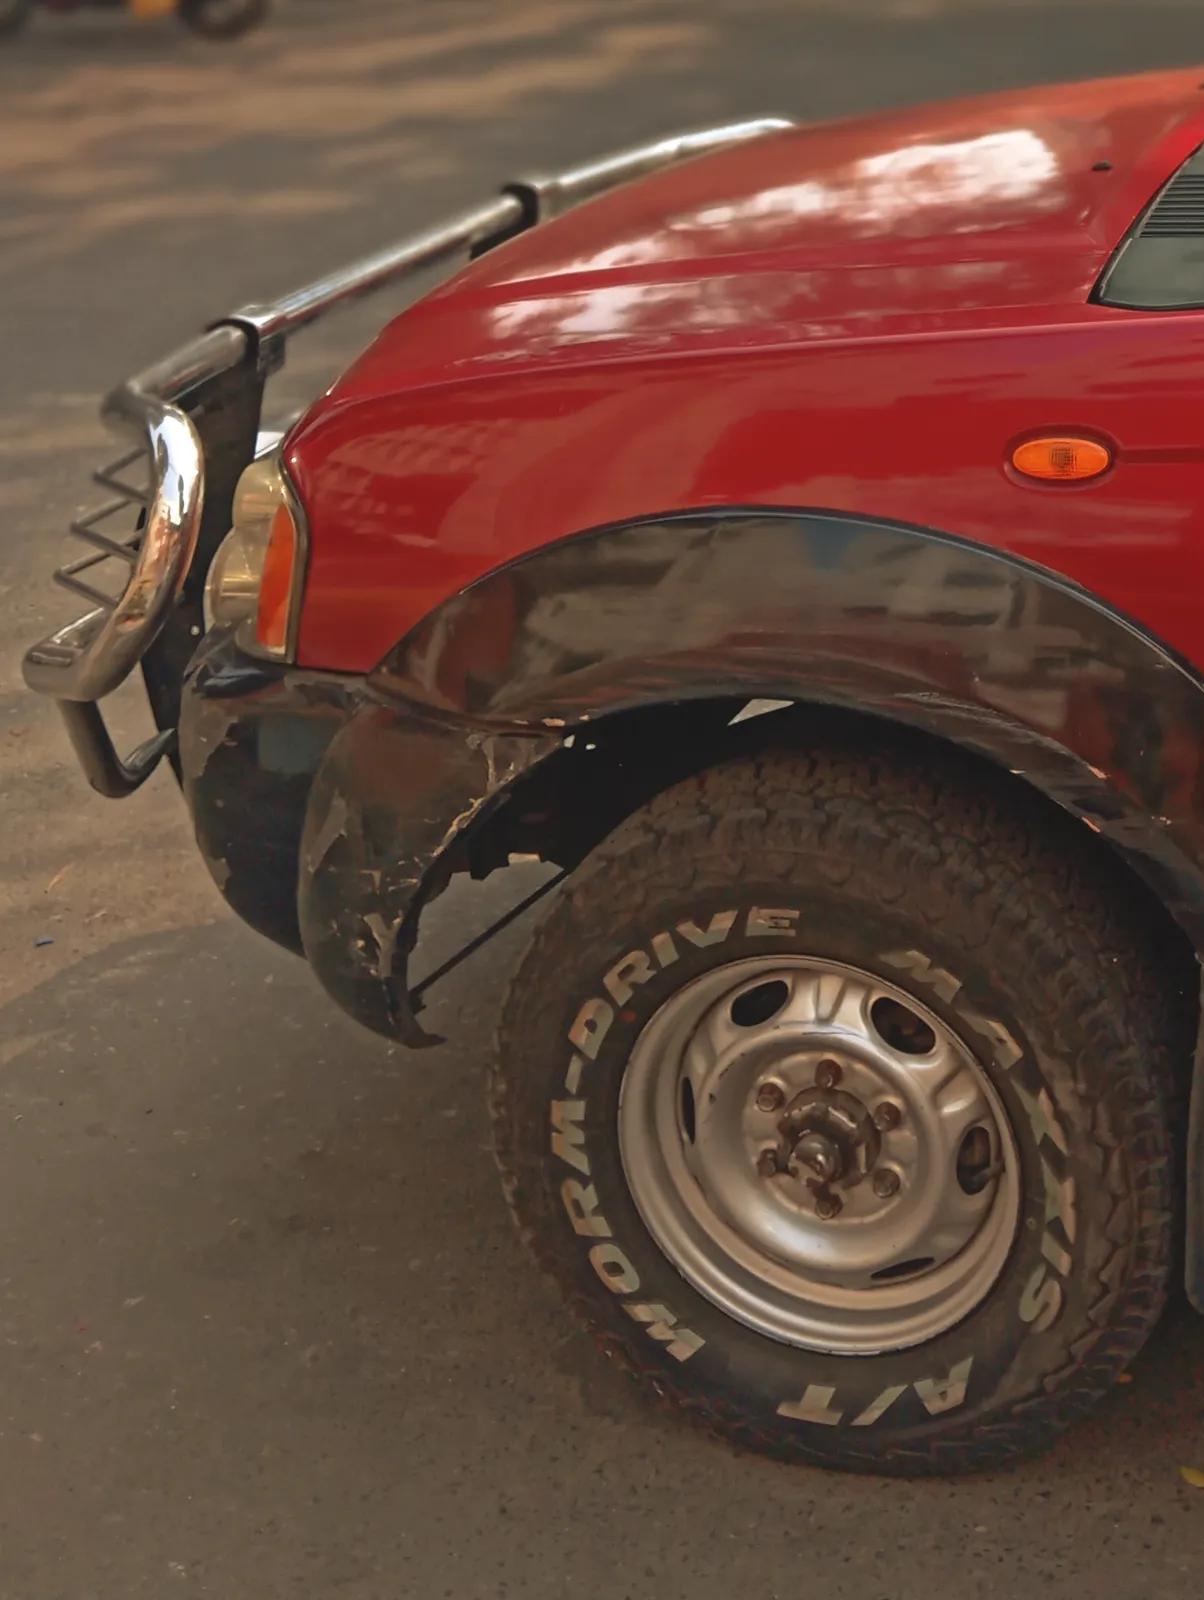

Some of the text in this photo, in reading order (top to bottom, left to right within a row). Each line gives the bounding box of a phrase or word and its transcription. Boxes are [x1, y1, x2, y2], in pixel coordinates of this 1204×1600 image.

[551, 905, 800, 1363] WORM-DRIVE
[879, 949, 1076, 1333] MAXXIS
[776, 1356, 974, 1426] A/T
